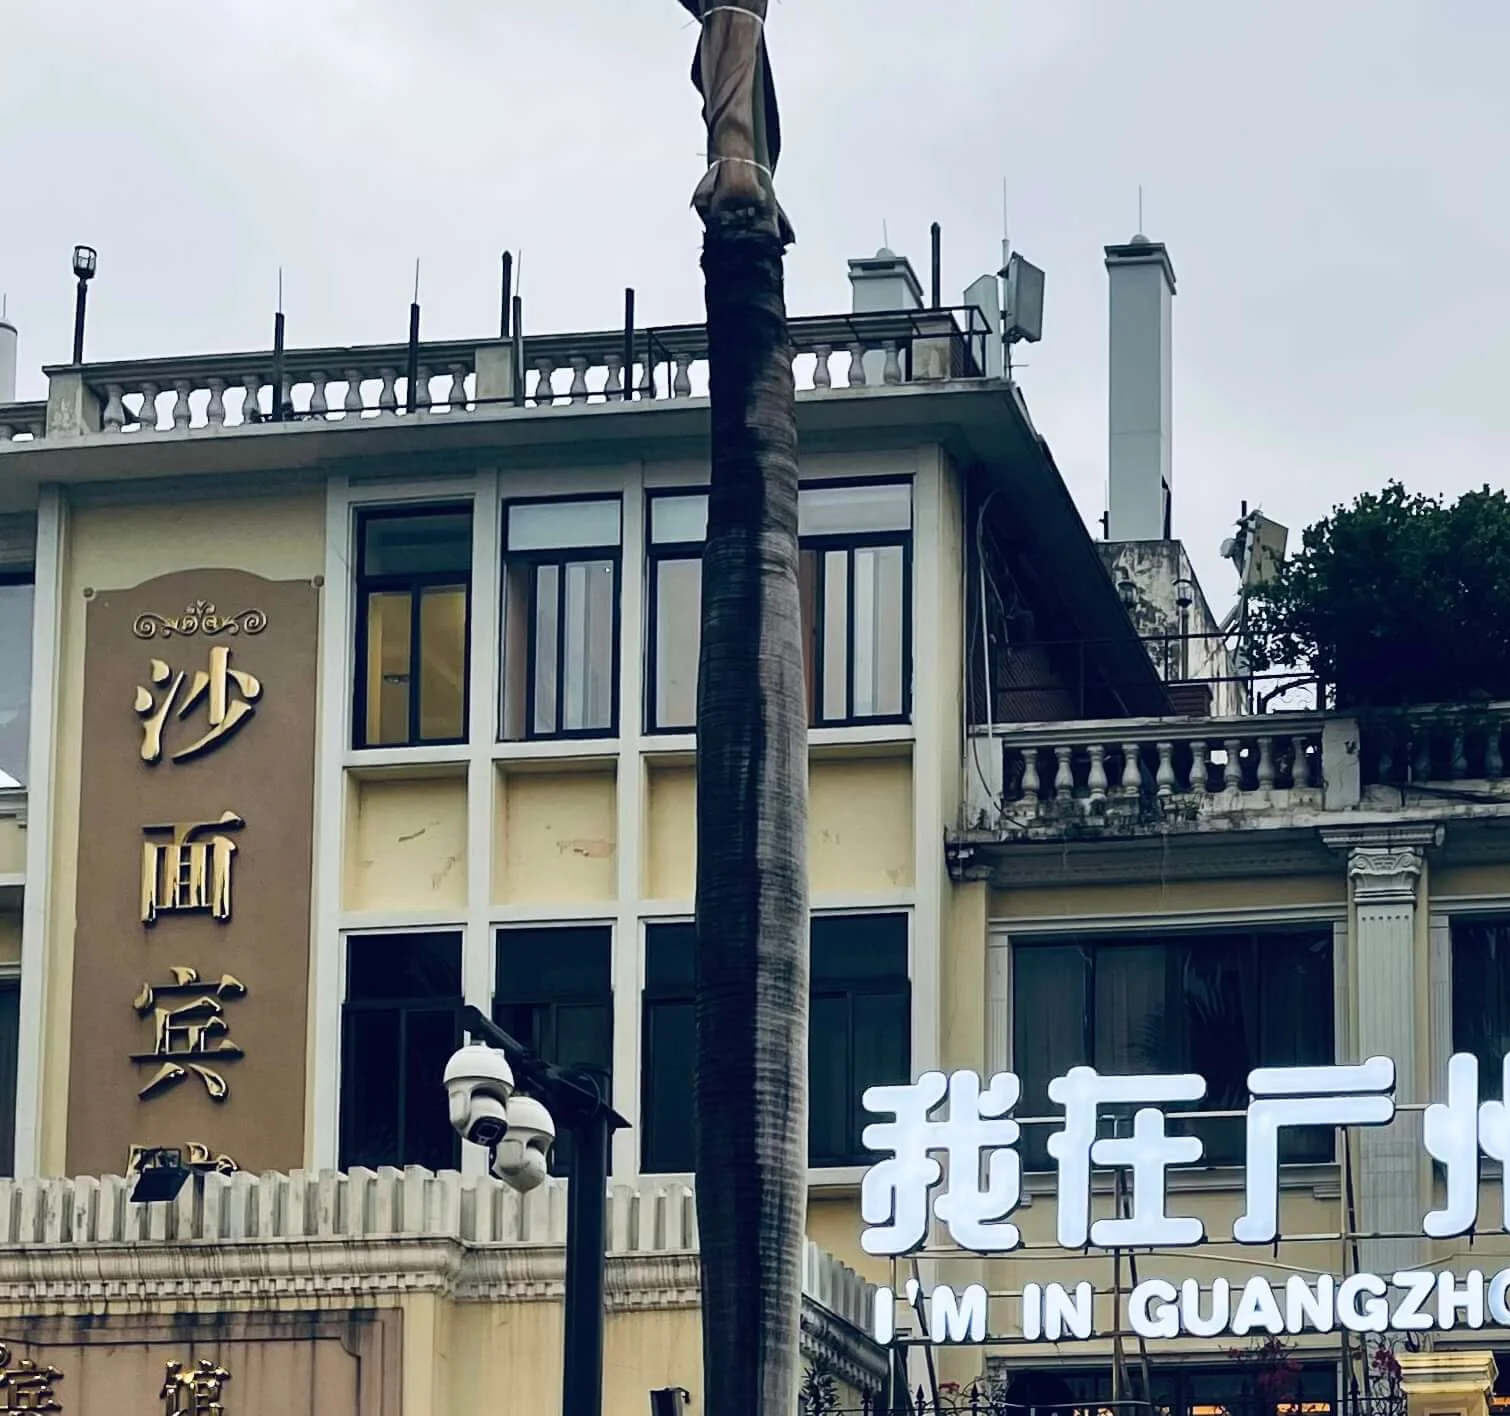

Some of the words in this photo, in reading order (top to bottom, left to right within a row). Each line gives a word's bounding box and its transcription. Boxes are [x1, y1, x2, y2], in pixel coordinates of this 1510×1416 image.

[129, 645, 262, 1175] 沙面宾
[874, 1278, 988, 1345] I'M
[1023, 1281, 1093, 1341] IN
